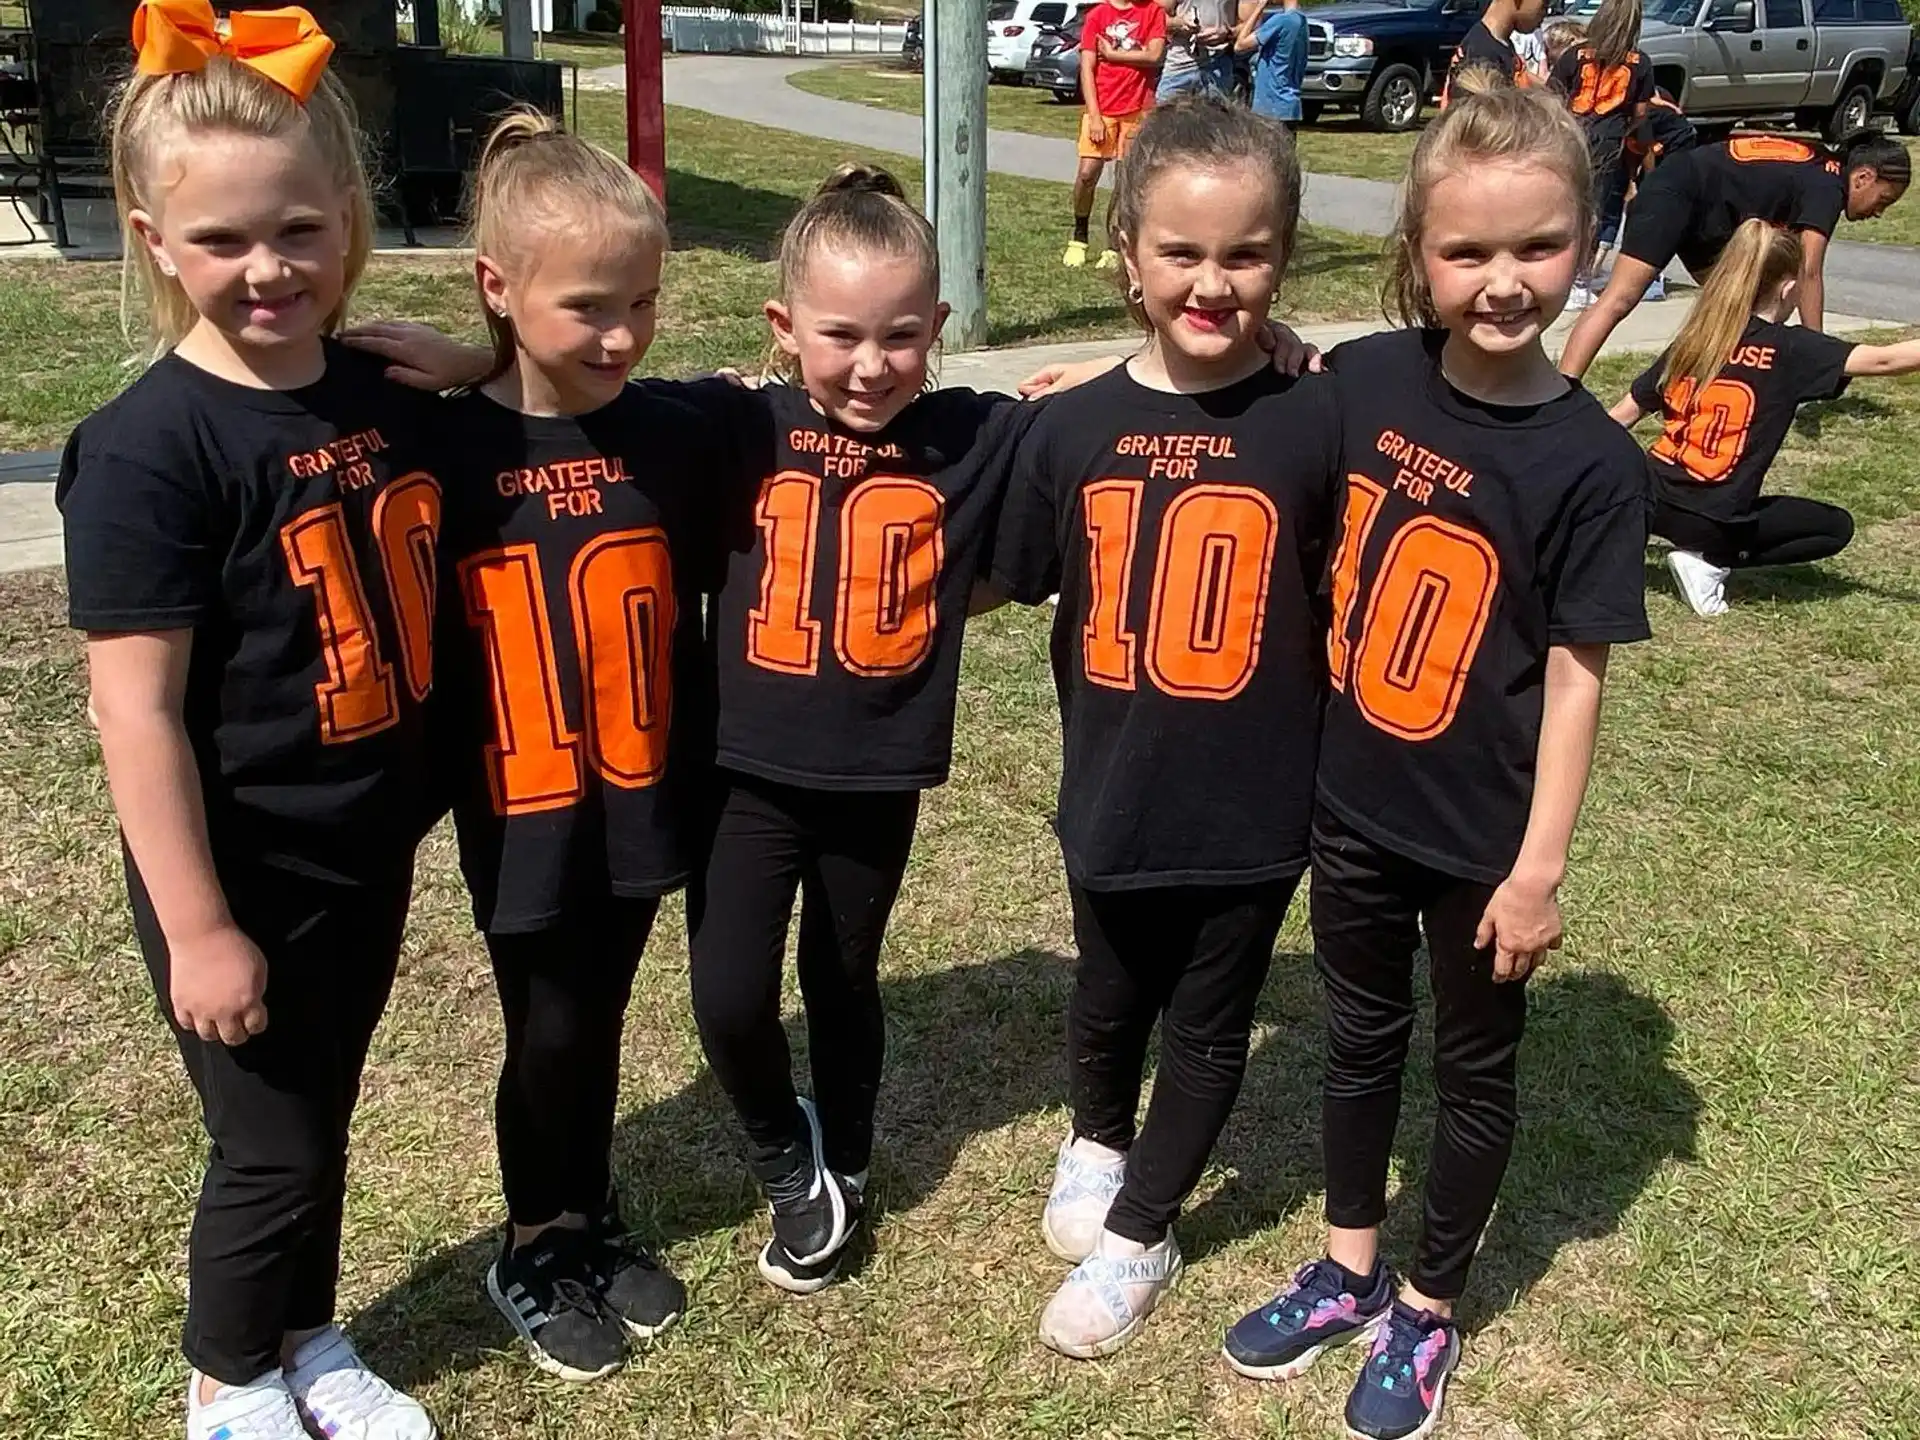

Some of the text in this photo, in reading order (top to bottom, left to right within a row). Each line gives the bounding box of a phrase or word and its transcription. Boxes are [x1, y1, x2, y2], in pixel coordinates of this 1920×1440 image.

[1728, 345, 1776, 370] USE
[288, 427, 390, 478] GRATEFUL
[788, 428, 902, 459] GRATEFUL
[1115, 433, 1236, 461] GRATEFUL
[336, 461, 376, 495] FOR
[495, 456, 635, 498] GRATEFUL
[823, 455, 869, 479] FOR
[1149, 456, 1199, 481] FOR
[1376, 428, 1474, 498] GRATEFUL
[547, 487, 604, 521] FOR
[1392, 467, 1435, 507] FOR
[746, 470, 946, 678] 10
[1081, 478, 1280, 702] 10
[280, 470, 442, 746] 10
[457, 527, 679, 816] 10
[1115, 1259, 1160, 1280] DKNY
